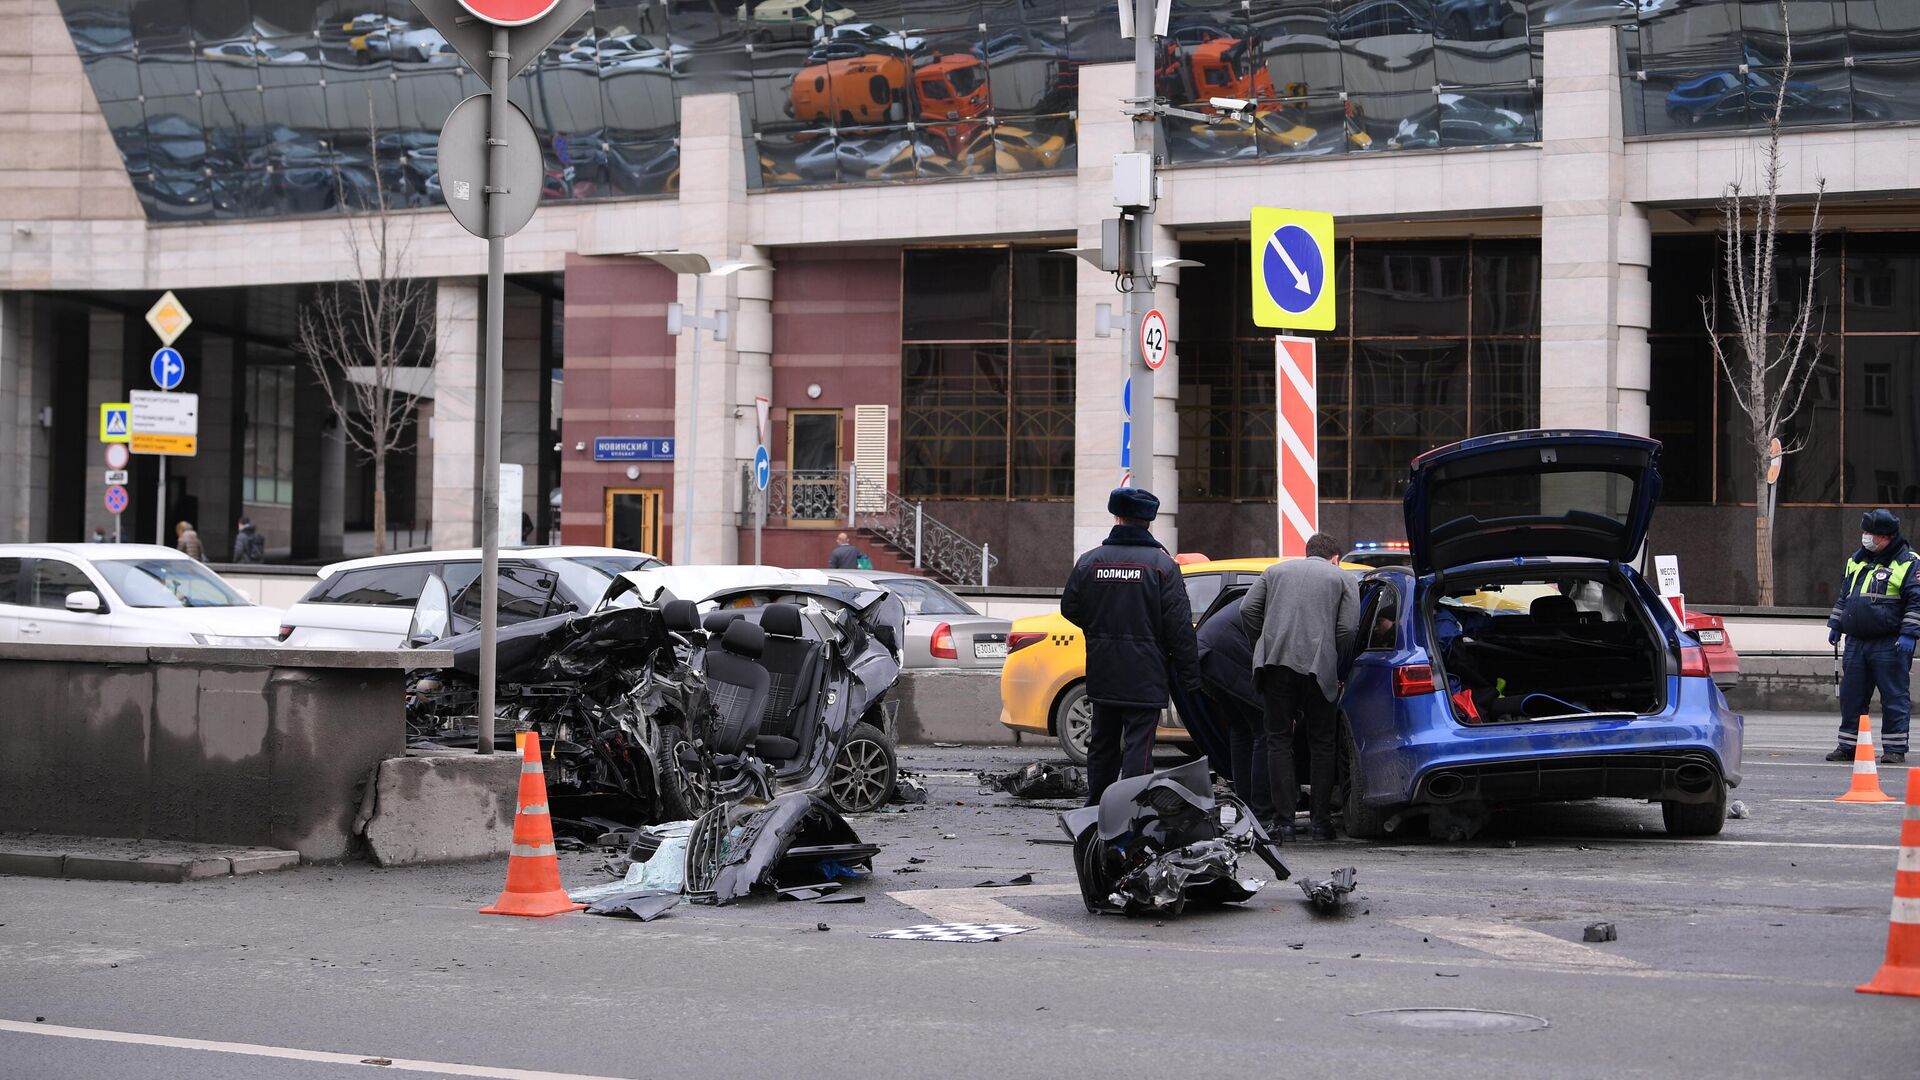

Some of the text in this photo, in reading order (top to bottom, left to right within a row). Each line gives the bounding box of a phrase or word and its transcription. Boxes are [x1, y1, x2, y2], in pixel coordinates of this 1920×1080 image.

[1146, 328, 1162, 350] 42
[599, 441, 648, 451] НОВИНСКИЙ
[661, 441, 670, 453] 8
[1097, 569, 1141, 580] ПОЛИЦИЯ
[1660, 567, 1677, 576] МЕСТО
[1664, 578, 1674, 586] ДТП
